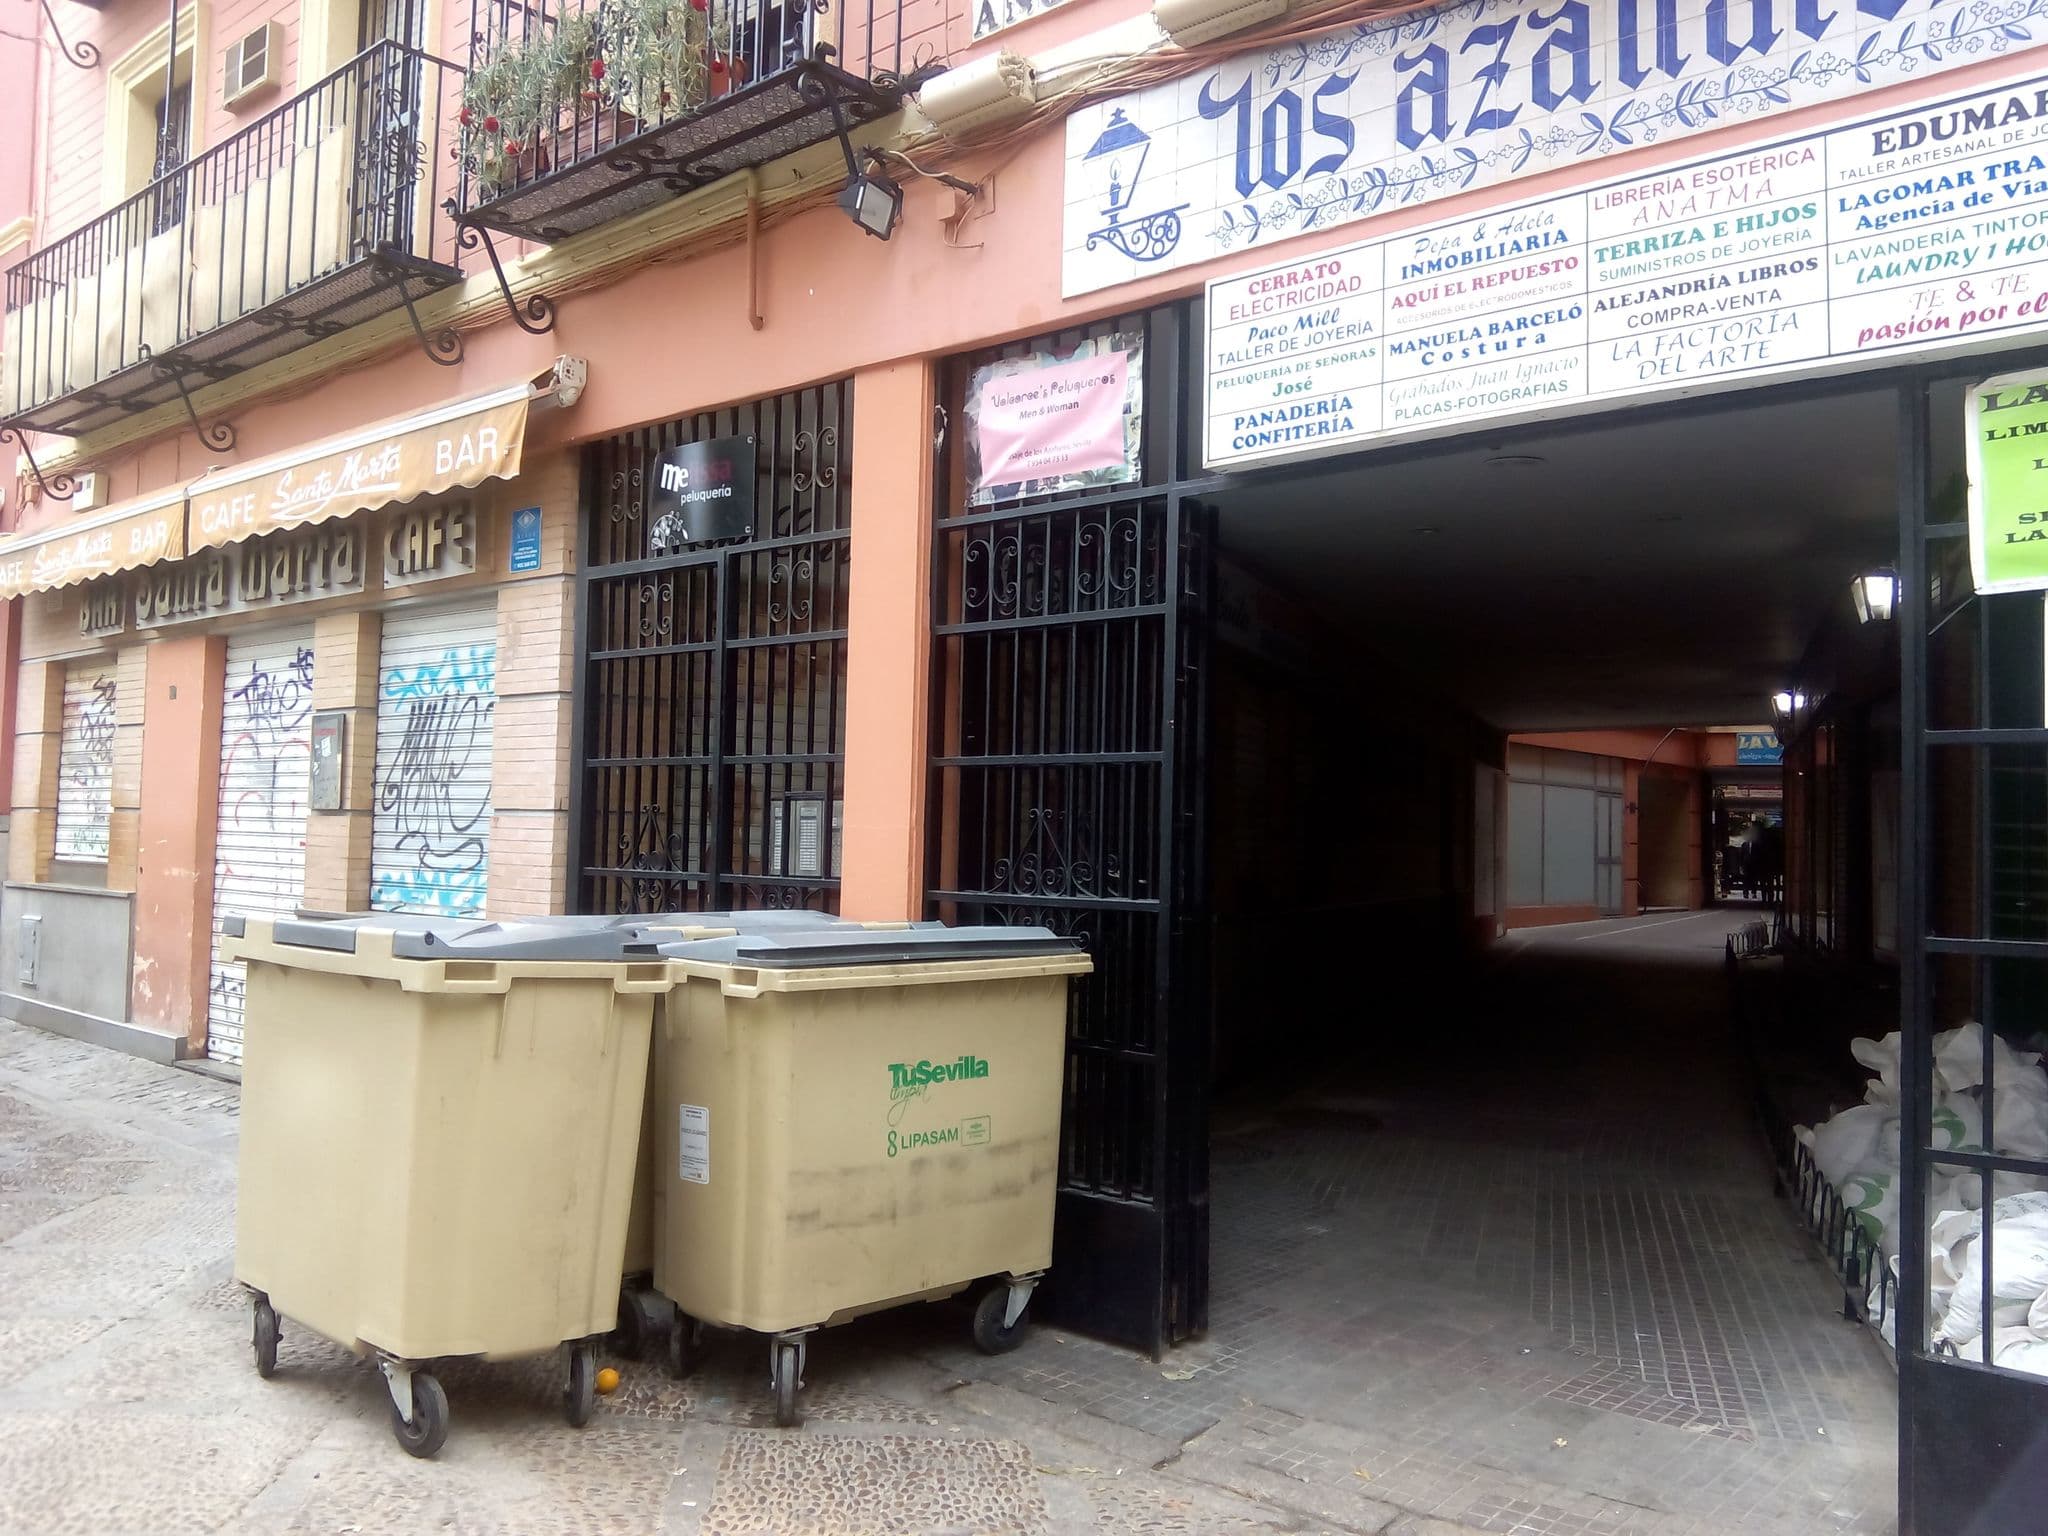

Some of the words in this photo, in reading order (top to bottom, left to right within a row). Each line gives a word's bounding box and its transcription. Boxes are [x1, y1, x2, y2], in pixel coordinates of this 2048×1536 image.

[1840, 160, 1895, 180] TALLER
[1901, 137, 1996, 167] ARTESANAL
[2003, 129, 2024, 144] DE
[1595, 177, 1685, 210] LIBRERÍA
[1693, 148, 1815, 188] ESOTÉRICA
[1839, 170, 1975, 212] LAGOMAR
[1983, 155, 2045, 181] TRA
[1633, 179, 1772, 226] ANATMA
[1855, 199, 1954, 231] Agencia
[1963, 192, 1993, 208] de
[1473, 222, 1486, 242] &
[1494, 211, 1555, 238] Adela
[1594, 227, 1706, 263] TERRIZA
[1713, 222, 1729, 238] E
[1736, 203, 1817, 233] HIJOS
[1835, 227, 1964, 265] LAVANDERÍA
[1402, 229, 1569, 280] INMOBILIARIA
[1600, 250, 1706, 281] SUMINISTROS
[1712, 245, 1732, 259] DE
[1739, 229, 1812, 253] JOYERÍA
[1857, 245, 1980, 284] LAUNDRY
[1988, 243, 1997, 259] 1
[1230, 276, 1361, 320] ELECTRICIDAD
[1249, 261, 1341, 295] CERRATO
[1392, 284, 1440, 309] AQUÍ
[1444, 282, 1467, 297] EL
[1472, 256, 1579, 291] REPUESTO
[1594, 274, 1731, 313] ALEJANDRÍA
[1739, 257, 1818, 284] LIBROS
[1956, 280, 1975, 302] &
[1248, 325, 1288, 343] Paco
[1293, 307, 1340, 332] Mill
[1627, 289, 1781, 328] COMPRA-VENTA
[1858, 310, 1950, 347] pasión
[1959, 304, 2007, 331] por
[2017, 291, 2048, 315] el
[1218, 344, 1273, 366] TALLER
[1279, 337, 1298, 352] DE
[1305, 321, 1373, 347] JOYERÍA
[1390, 327, 1483, 356] MANUELA
[1489, 303, 1583, 336] BARCELÓ
[1422, 333, 1546, 366] Costura
[1613, 341, 1641, 361] LA
[1655, 309, 1798, 356] FACTORÍA
[1216, 365, 1291, 389] PELUQUERÍA
[1296, 361, 1312, 373] DE
[1315, 348, 1376, 368] SEÑORAS
[1637, 355, 1688, 379] DEL
[1699, 339, 1771, 369] ARTE
[1273, 376, 1313, 397] José
[1395, 380, 1568, 420] PLACAS-FOTOGRAFIAS
[1019, 408, 1037, 420] Men
[1047, 401, 1079, 413] Woman
[1235, 396, 1353, 430] PANADERÍA
[1233, 416, 1354, 450] CONFITERÍA
[201, 494, 256, 533] CAFE
[272, 470, 332, 507] Santa
[337, 444, 401, 490] Marta
[436, 428, 499, 475] BAR
[680, 484, 732, 506] peluquería
[129, 520, 167, 554] BAR
[888, 1056, 989, 1088] TuSevilla
[901, 1127, 959, 1150] LIPASAM
